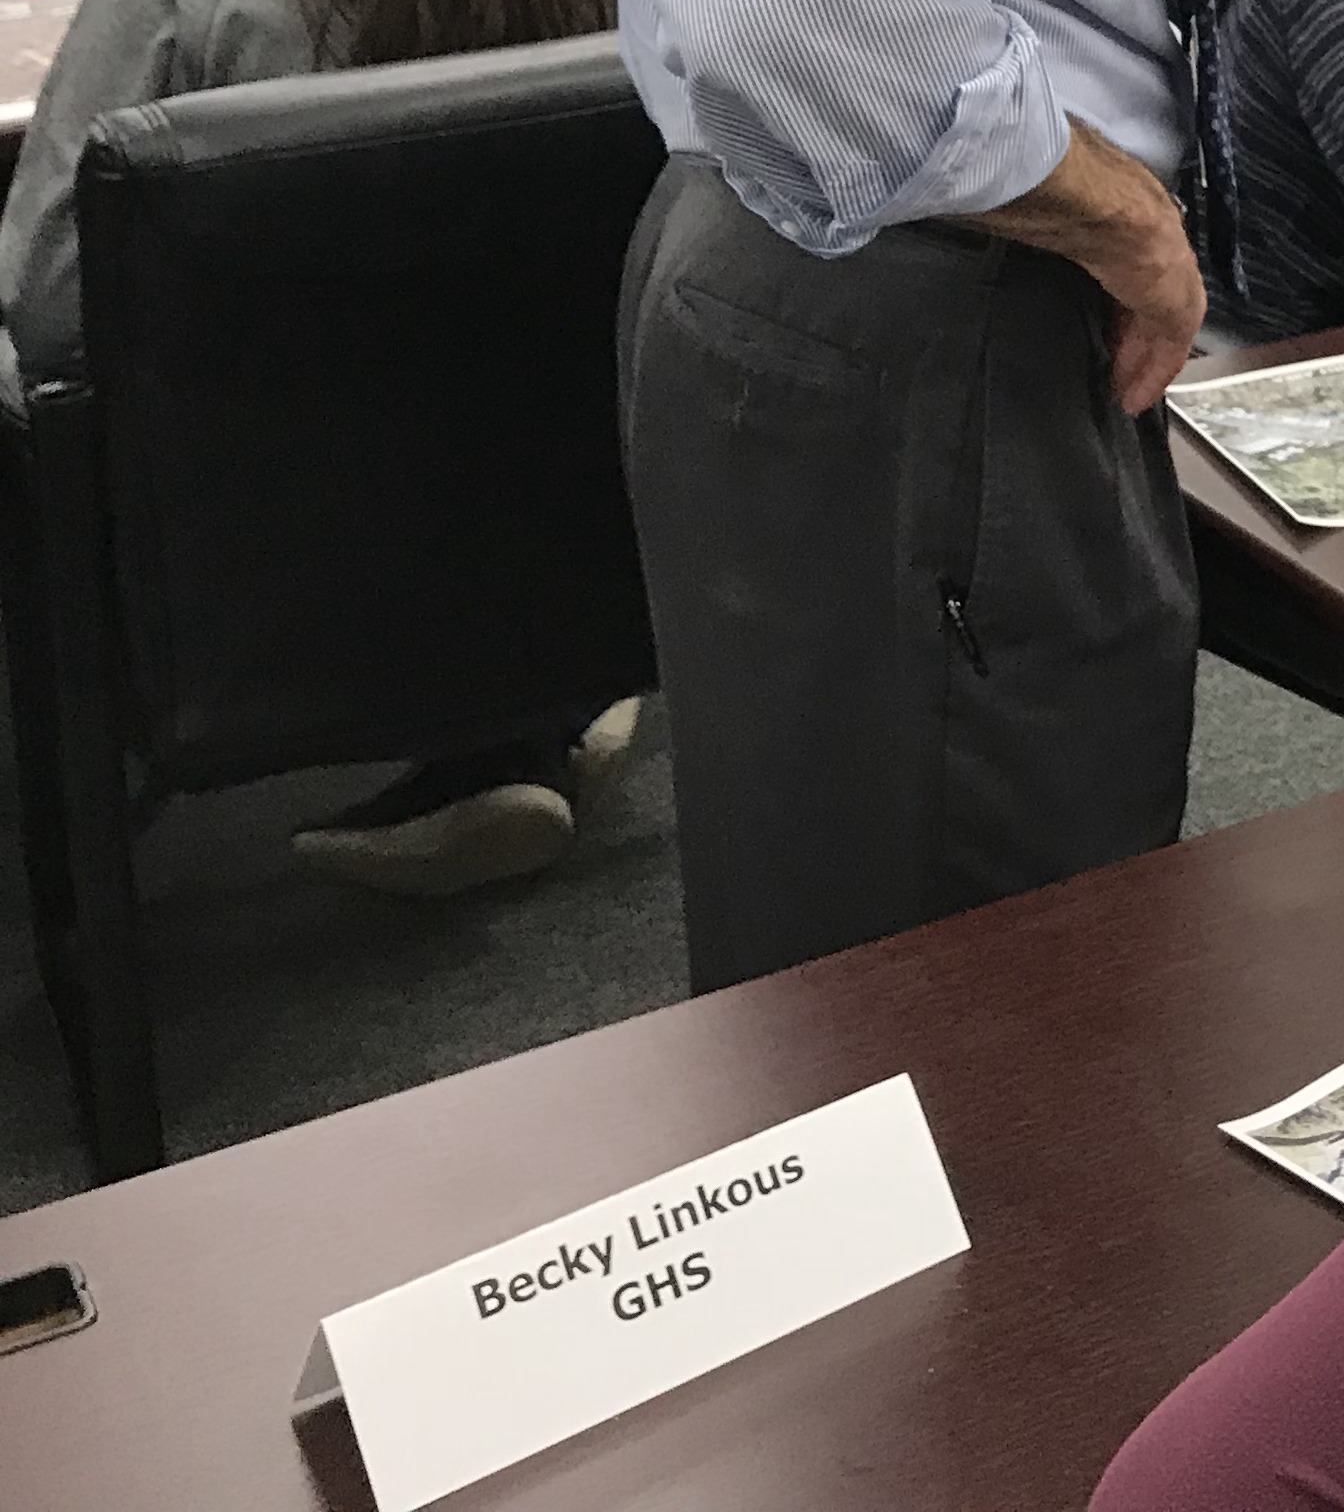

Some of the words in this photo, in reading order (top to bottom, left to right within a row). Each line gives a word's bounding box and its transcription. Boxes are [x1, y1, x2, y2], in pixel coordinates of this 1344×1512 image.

[471, 1234, 614, 1320] Becky
[627, 1154, 806, 1251] Linkous
[611, 1251, 712, 1322] GHS
